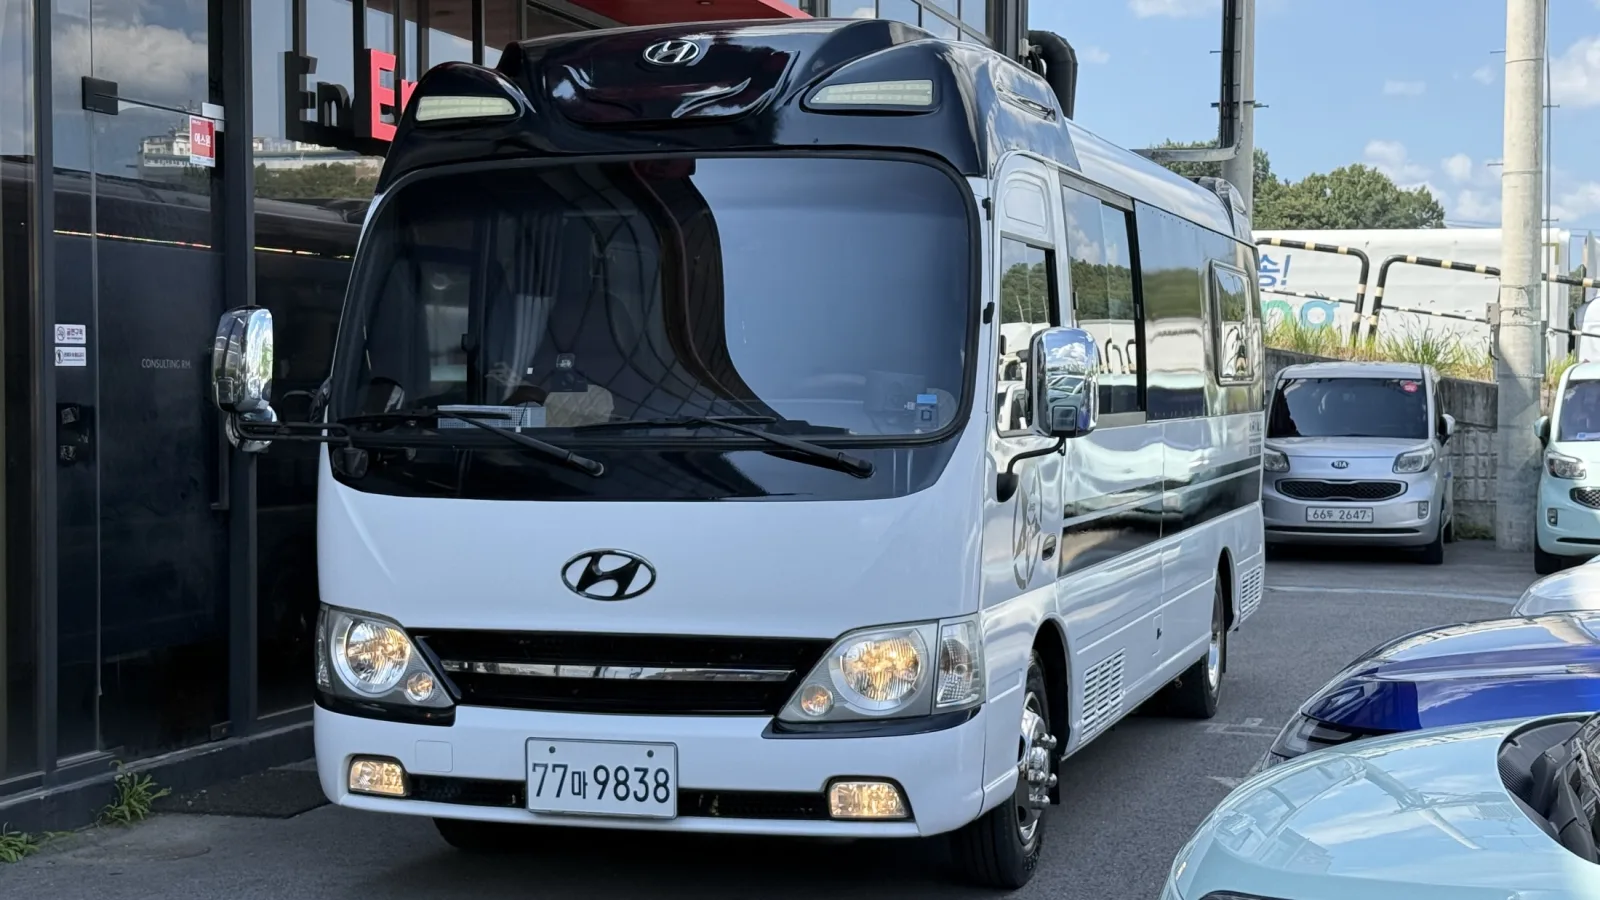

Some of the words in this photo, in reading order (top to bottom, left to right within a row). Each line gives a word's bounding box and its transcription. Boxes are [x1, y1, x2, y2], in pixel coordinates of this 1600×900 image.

[194, 132, 212, 148] 에스원
[141, 358, 181, 369] CONSULTING
[1312, 509, 1334, 520] 66두
[1338, 509, 1367, 520] 2647
